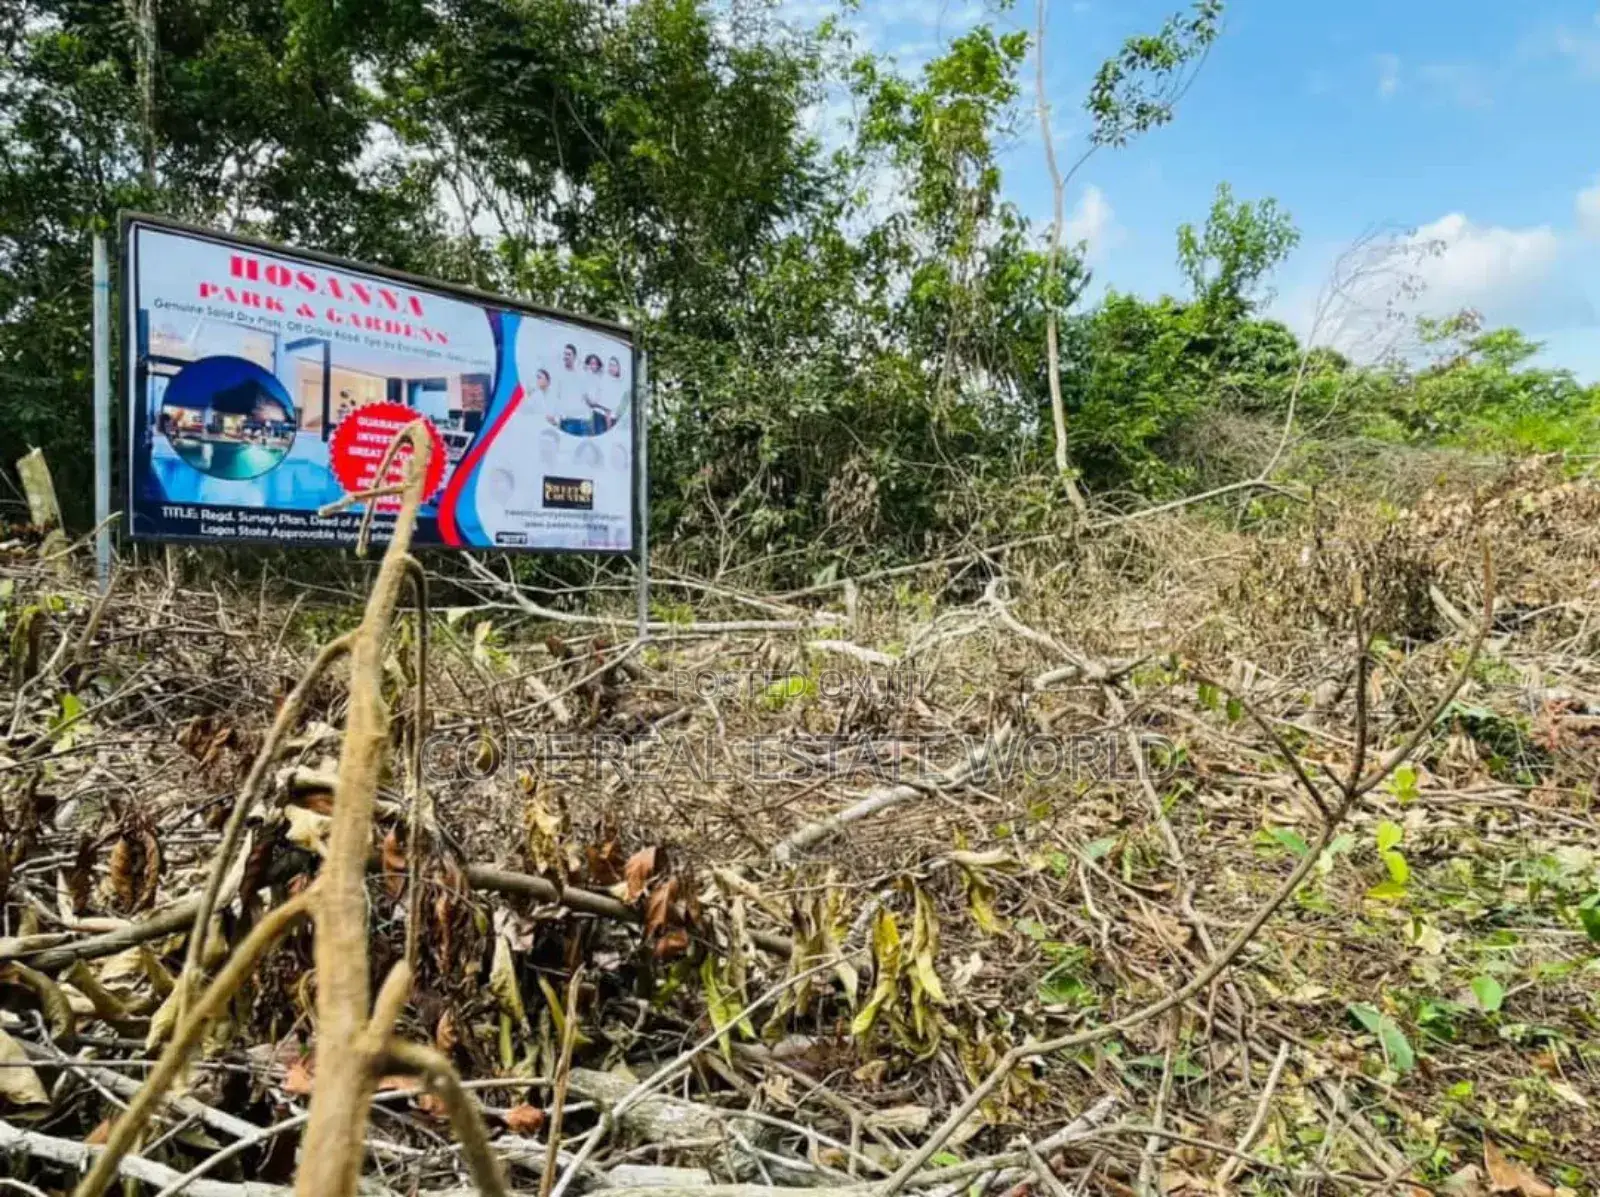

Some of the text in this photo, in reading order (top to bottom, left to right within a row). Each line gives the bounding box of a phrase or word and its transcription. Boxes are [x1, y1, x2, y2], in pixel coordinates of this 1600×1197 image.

[154, 298, 205, 315] Genuine
[230, 255, 424, 318] HOSANNA
[199, 282, 449, 345] PARK & GARDENS
[201, 523, 235, 537] Lagos
